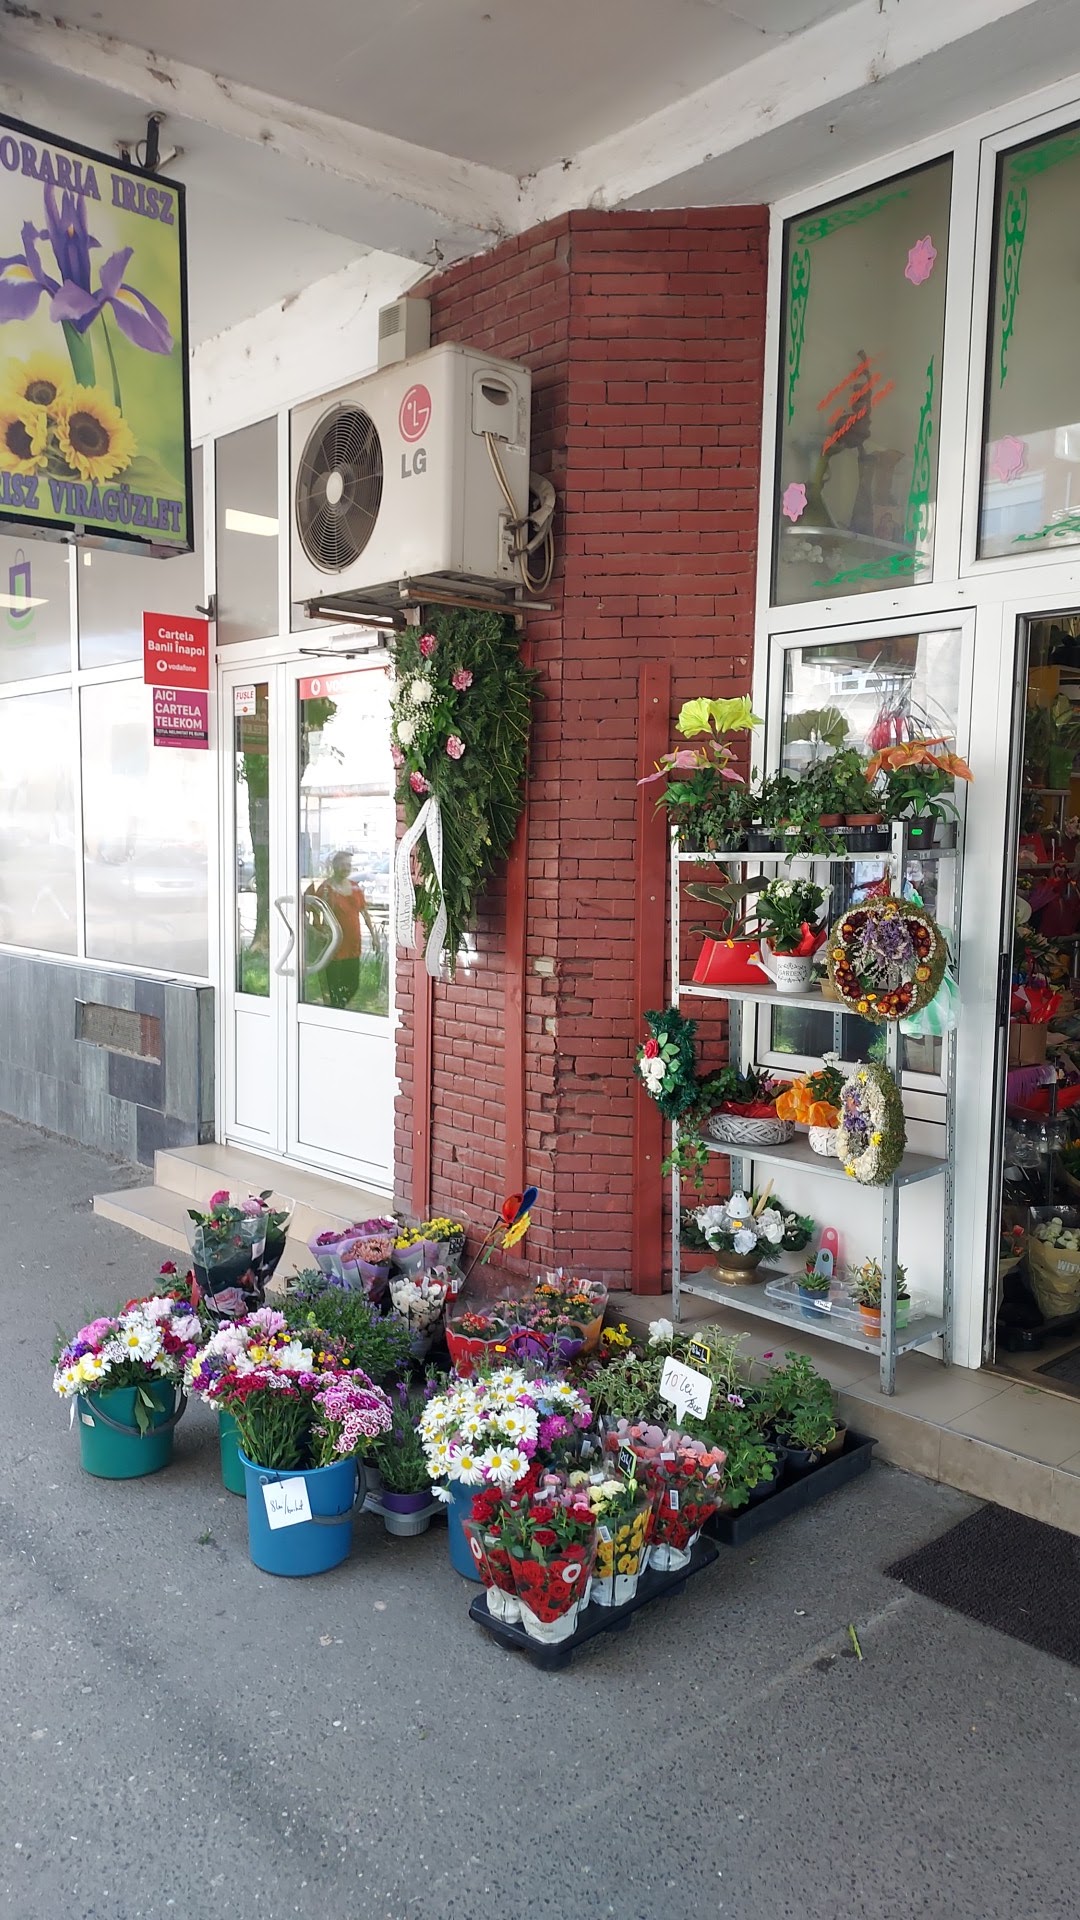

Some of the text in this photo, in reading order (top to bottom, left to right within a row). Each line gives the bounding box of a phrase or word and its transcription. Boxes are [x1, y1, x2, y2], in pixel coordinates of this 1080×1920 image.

[0, 135, 174, 226] ORARIA IRISZ
[401, 447, 428, 480] LG
[0, 471, 183, 532] ISZ VIRÁGÜZLET
[158, 627, 194, 642] Cartela
[148, 639, 206, 658] Banii Înapoi
[168, 664, 197, 673] vodafone
[155, 690, 176, 702] AICI
[155, 702, 202, 717] CARTELA
[155, 716, 203, 730] TELEKOM
